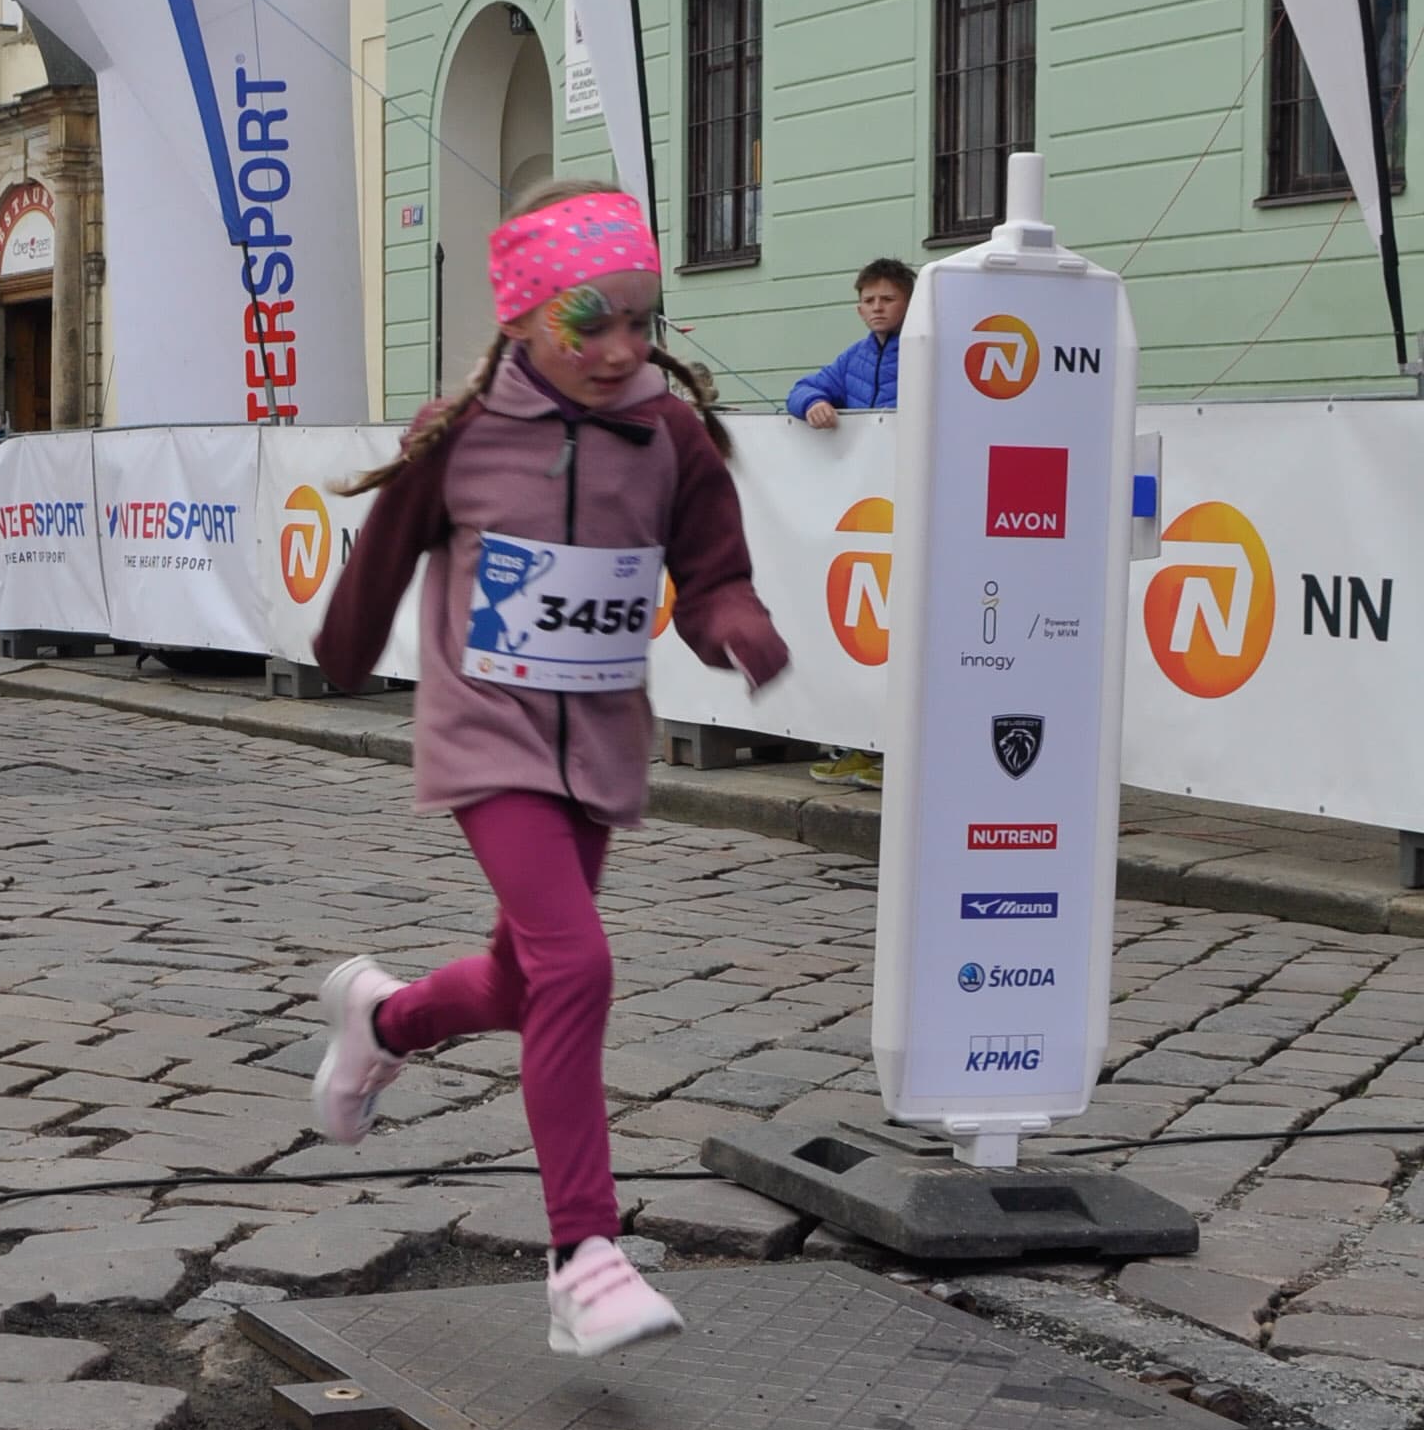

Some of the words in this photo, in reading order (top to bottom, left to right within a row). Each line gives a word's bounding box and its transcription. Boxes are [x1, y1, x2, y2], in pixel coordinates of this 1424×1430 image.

[1054, 346, 1101, 373] NN
[994, 512, 1057, 531] AVON
[161, 556, 173, 568] OF
[175, 556, 213, 571] SPORT
[535, 595, 648, 635] 3456
[1301, 573, 1393, 642] NN
[961, 652, 1015, 670] innogy
[973, 830, 1054, 845] NUTREND
[988, 965, 1056, 988] ŠKODA
[965, 1049, 1040, 1071] KPMG
